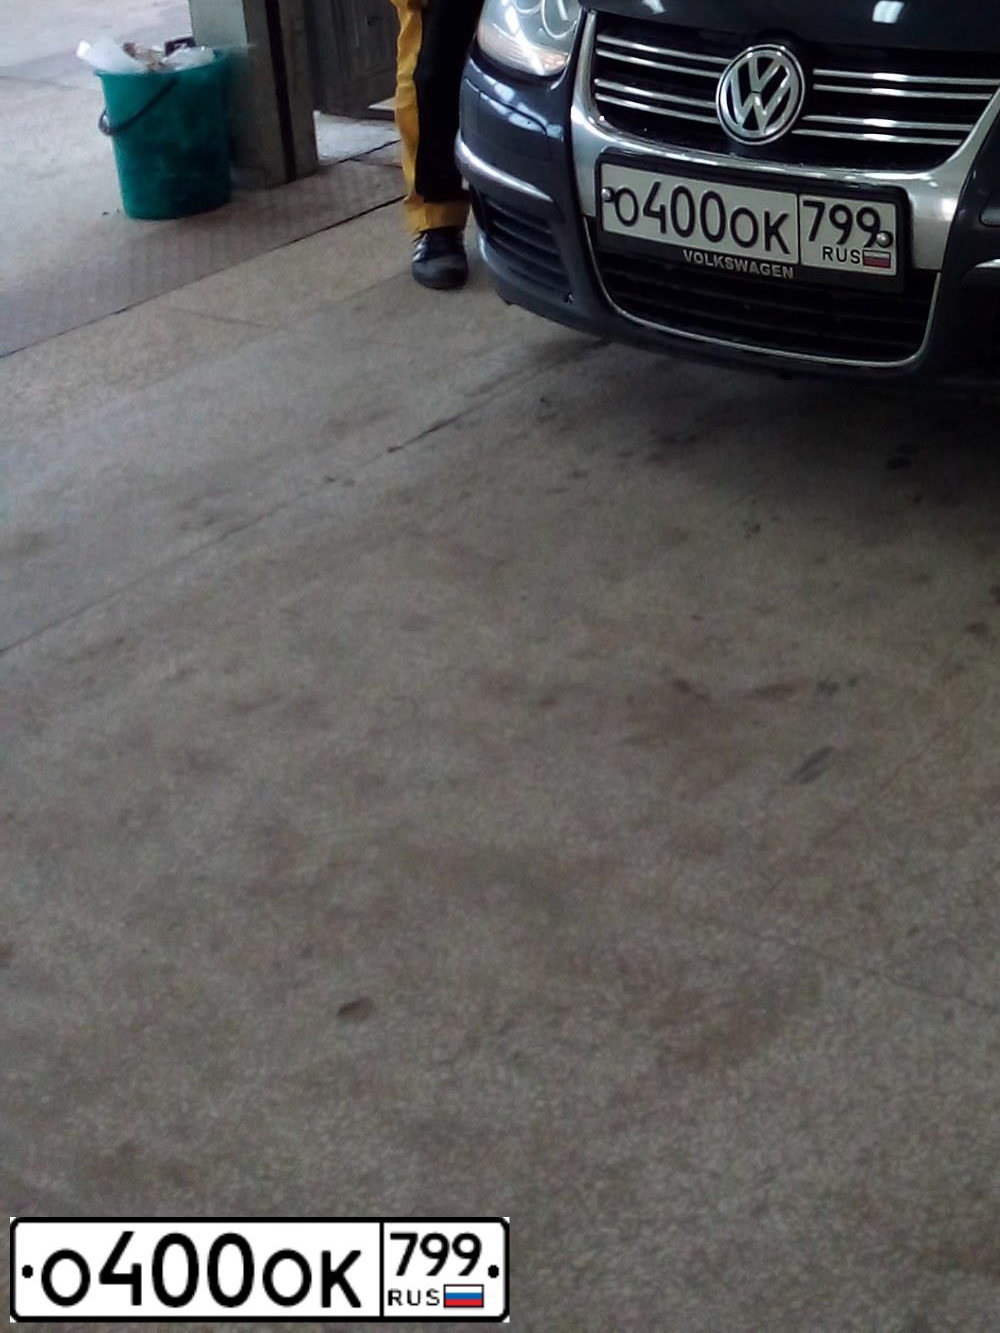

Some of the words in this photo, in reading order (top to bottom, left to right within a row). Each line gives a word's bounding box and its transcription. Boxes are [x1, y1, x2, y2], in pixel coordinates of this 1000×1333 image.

[802, 200, 881, 248] 799
[682, 248, 794, 280] VOLKSWAGEN
[822, 246, 861, 265] RUS
